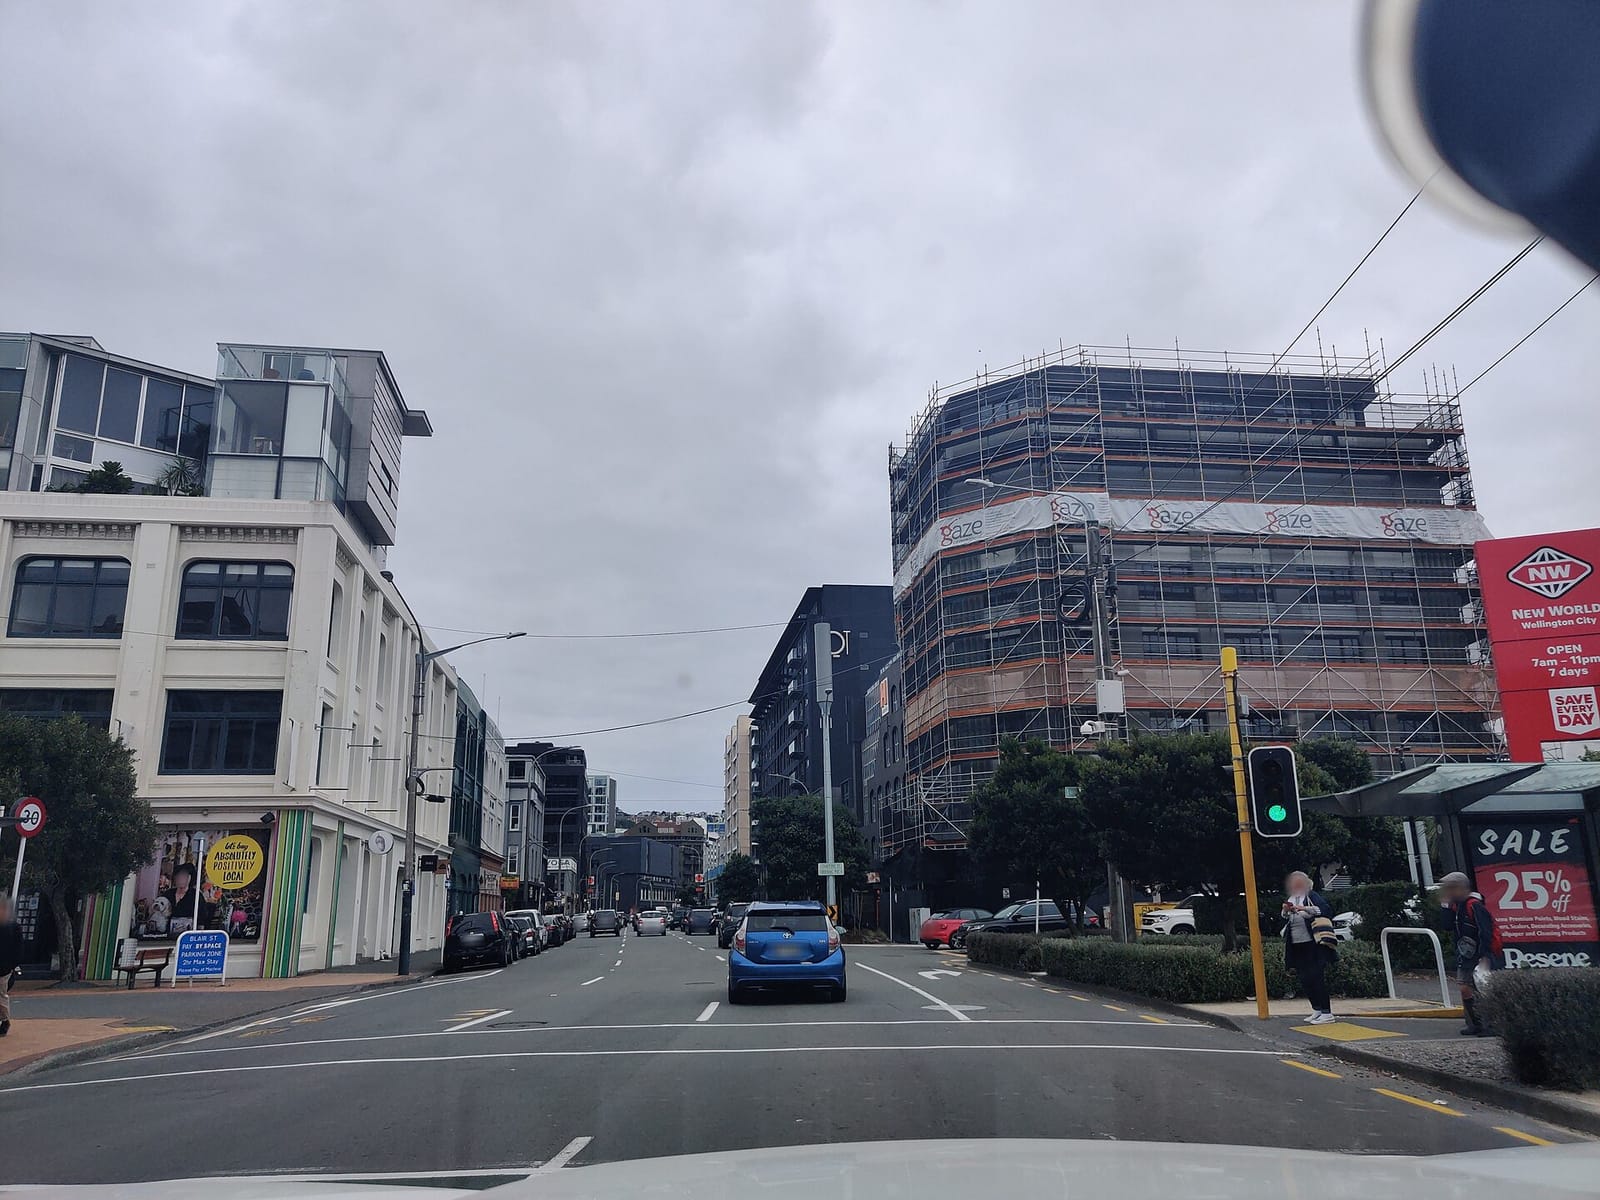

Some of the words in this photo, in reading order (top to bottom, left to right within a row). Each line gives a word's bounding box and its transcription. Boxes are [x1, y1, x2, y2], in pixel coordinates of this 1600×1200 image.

[1147, 505, 1194, 528] gaze
[1265, 510, 1312, 532] gaze
[940, 518, 983, 546] gaze
[1380, 513, 1427, 537] gaze
[1527, 564, 1571, 581] NW
[1511, 608, 1545, 620] NEW
[1548, 603, 1600, 617] WORLD
[1521, 618, 1575, 630] Wellington
[1576, 616, 1597, 626] City
[1546, 644, 1582, 655] OPEN
[1531, 658, 1558, 667] 7am
[1570, 655, 1600, 665] 11pm
[1548, 668, 1556, 677] 7
[1559, 667, 1589, 677] days
[1555, 694, 1593, 705] SAVE
[1556, 704, 1594, 713] EVERY
[1558, 712, 1595, 726] DAY
[23, 809, 40, 825] 30
[1478, 828, 1570, 856] SALE
[213, 851, 256, 861] ABSOLUTELY
[213, 861, 255, 870] POSITIVELY
[223, 871, 244, 881] LOCAL
[1494, 869, 1571, 910] 25%
[1551, 894, 1571, 913] off
[1502, 948, 1591, 969] Resene
